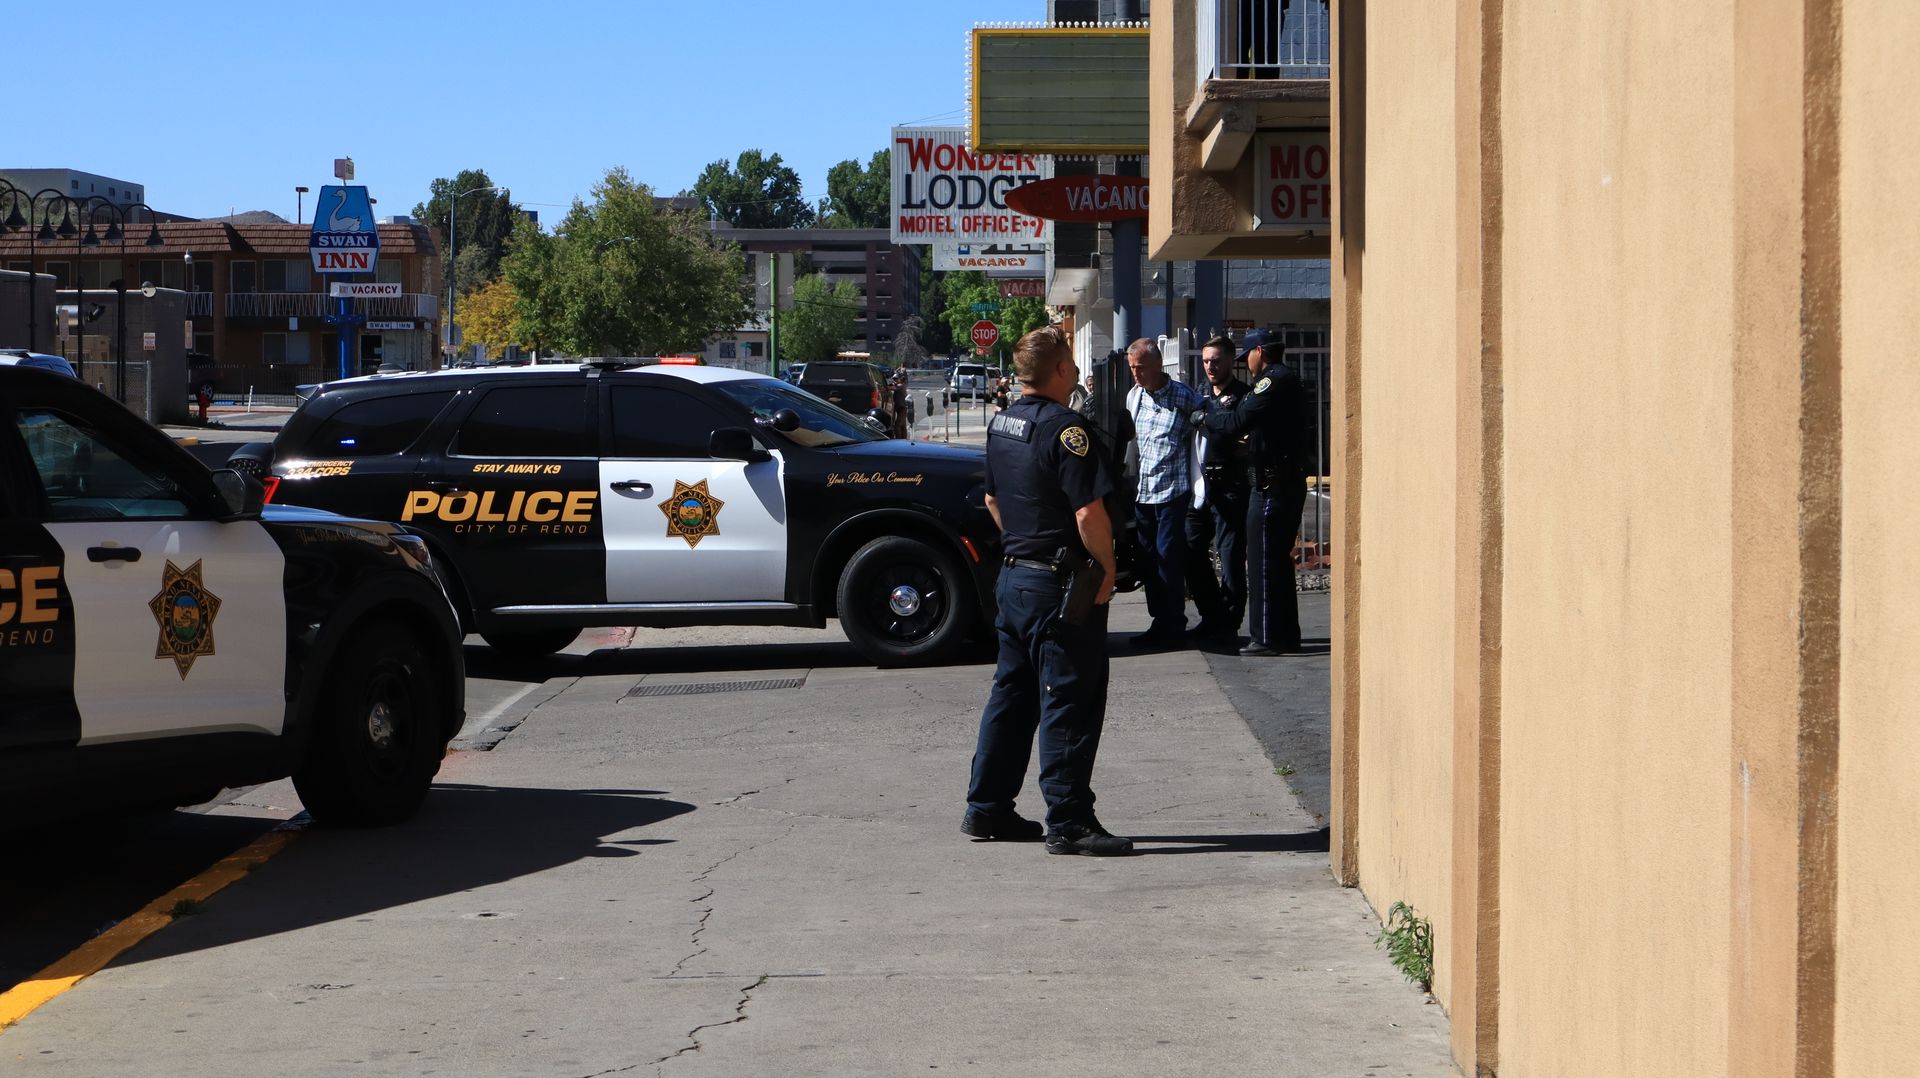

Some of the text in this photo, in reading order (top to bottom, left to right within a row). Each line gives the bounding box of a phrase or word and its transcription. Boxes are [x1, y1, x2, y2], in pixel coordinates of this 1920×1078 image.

[896, 138, 1036, 172] WONDER
[1270, 145, 1329, 179] MO
[901, 174, 1041, 210] LODG
[900, 215, 1021, 232] MOTEL OFFICE
[318, 235, 369, 247] SWAN
[318, 252, 370, 269] INN
[958, 257, 1027, 267] VACANCY
[351, 285, 398, 294] VACANCY
[973, 328, 997, 340] STOP
[1003, 417, 1027, 437] POLICE
[472, 464, 562, 474] STAY AWAY K9
[847, 471, 870, 484] Police
[400, 490, 599, 522] POLICE
[455, 524, 588, 534] CITY OF RENO
